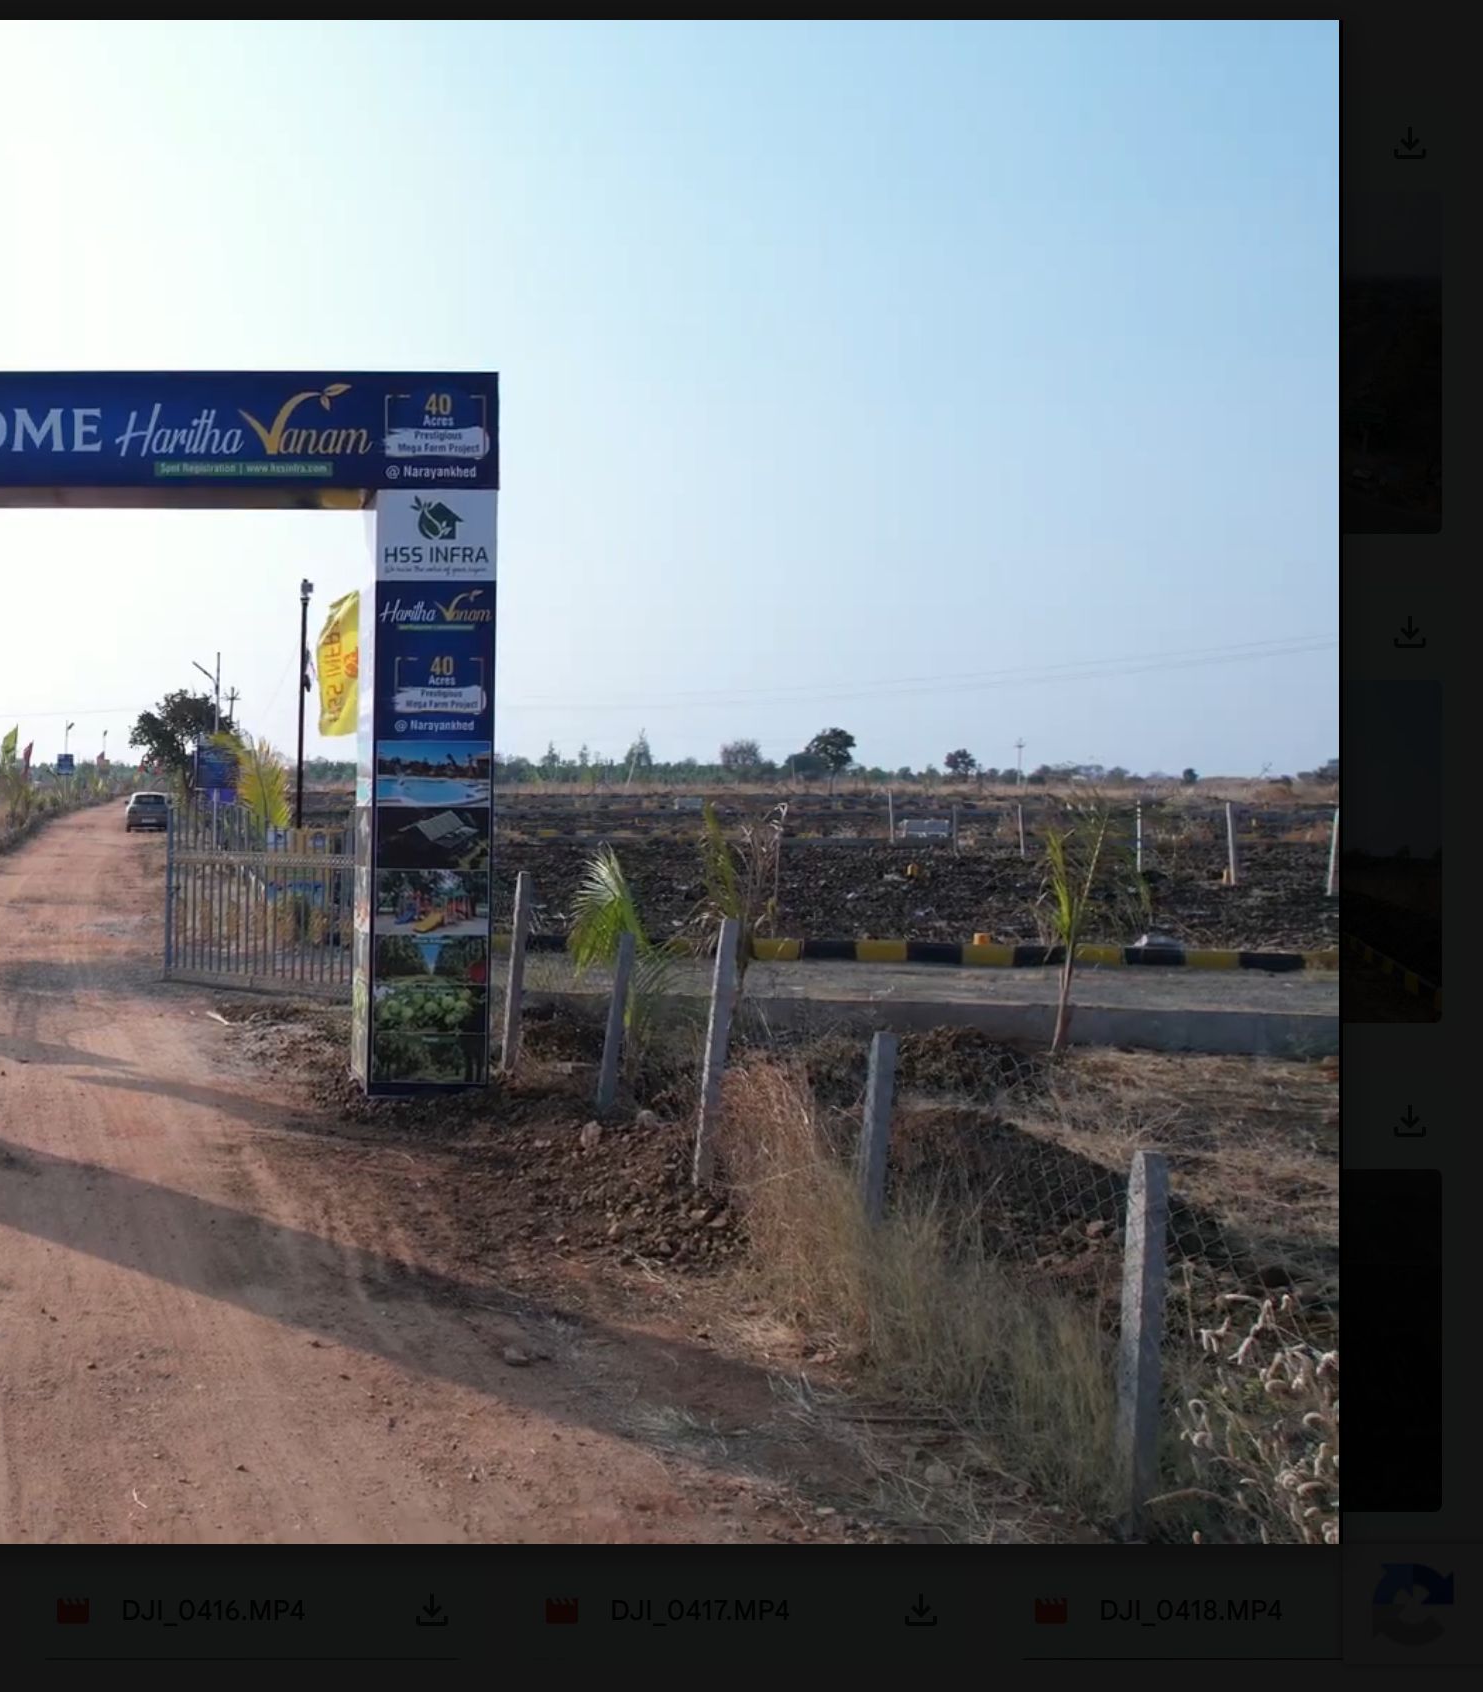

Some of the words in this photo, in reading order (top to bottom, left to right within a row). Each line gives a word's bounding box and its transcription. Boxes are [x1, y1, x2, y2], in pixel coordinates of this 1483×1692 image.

[425, 393, 452, 415] 40
[115, 402, 245, 458] Haritha
[237, 383, 374, 456] Vanam
[423, 415, 454, 427] Acres
[414, 430, 462, 441] Prestigious
[398, 443, 421, 454] Mega
[424, 443, 446, 453] Farm
[449, 443, 480, 454] Project
[403, 465, 477, 480] Narayankhed
[384, 546, 423, 563] HSS
[429, 546, 489, 563] INFRA
[379, 599, 436, 623] Haritha
[433, 589, 492, 621] Vanam
[430, 656, 454, 676] 40
[428, 675, 456, 686] Acres
[410, 719, 475, 732] Narayankhed
[123, 1599, 305, 1627] DJI_0416.MP4
[612, 1599, 789, 1627] DJI_0417.MP4
[1101, 1599, 1282, 1627] DJI_0418.MP4
